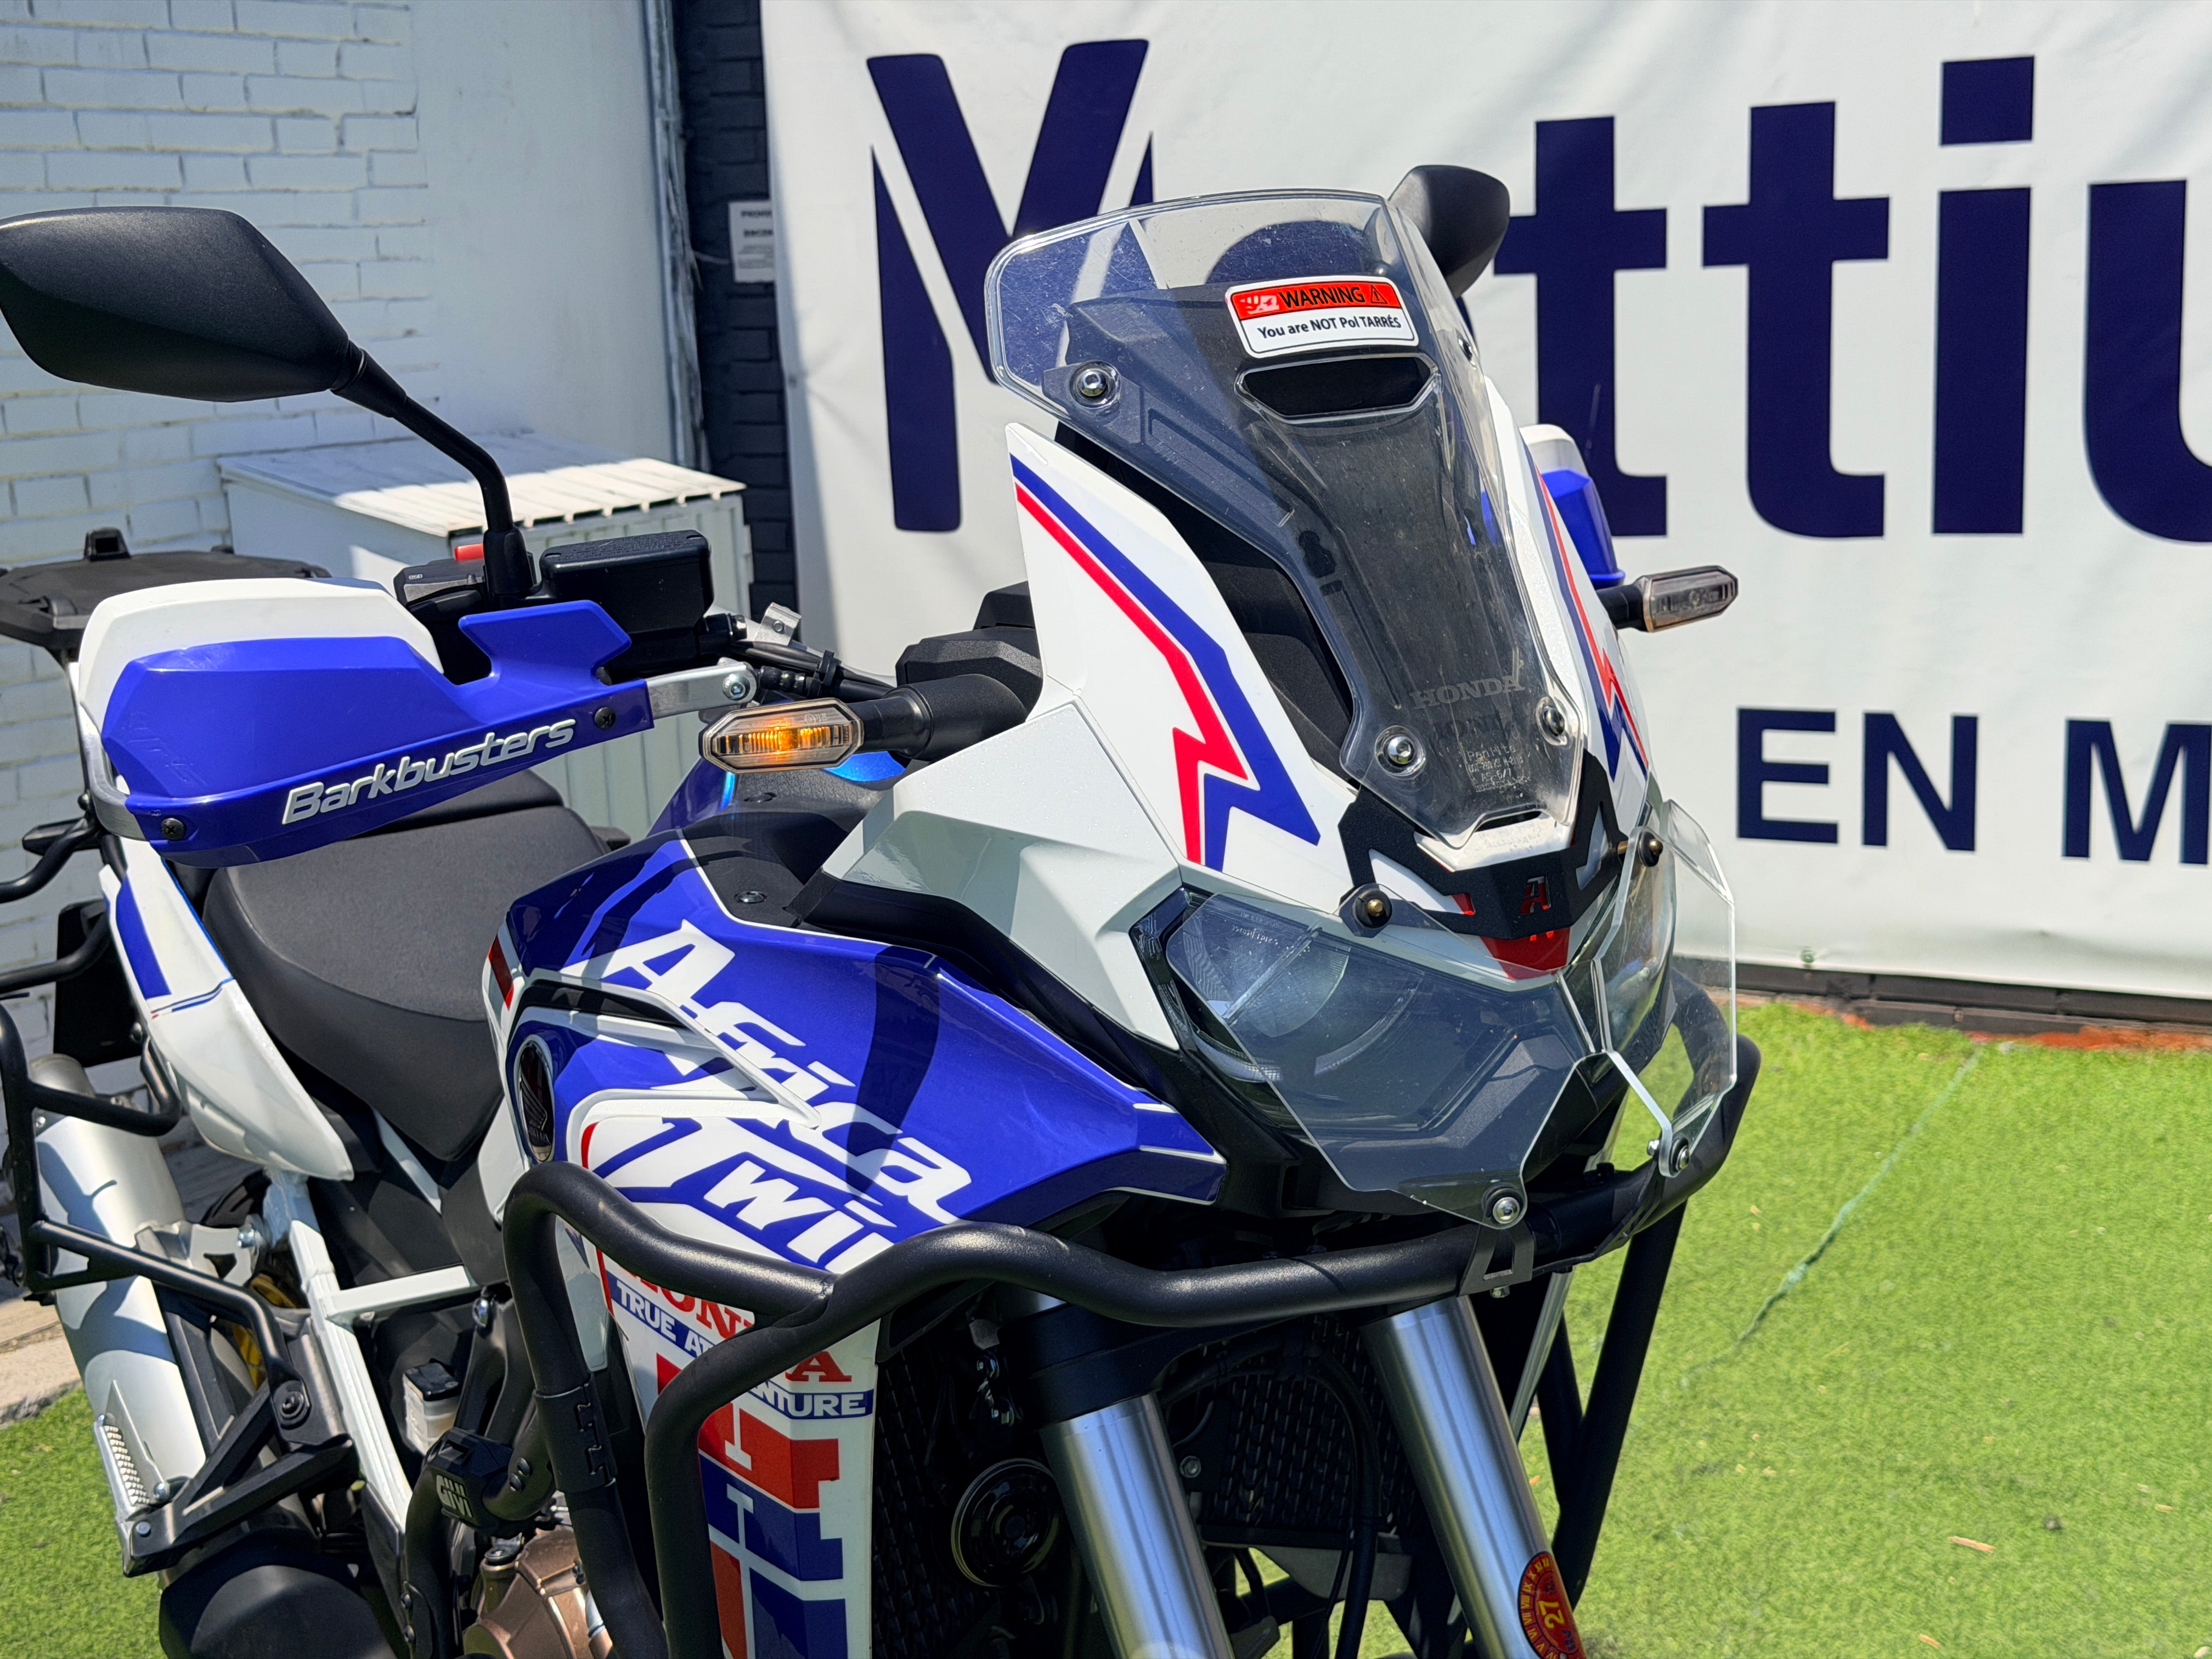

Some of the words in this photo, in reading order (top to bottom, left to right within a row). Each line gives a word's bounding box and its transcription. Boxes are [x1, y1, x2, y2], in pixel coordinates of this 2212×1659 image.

[1278, 286, 1365, 308] WARNING
[1257, 326, 1285, 339] You
[1288, 323, 1310, 334] are
[1310, 317, 1336, 331] NOT
[1340, 315, 1359, 329] Pol
[1359, 313, 1401, 329] TARRÉS
[1408, 675, 1525, 709] HONDA
[282, 719, 576, 825] Barkbusters
[1736, 707, 1979, 853] EN
[560, 919, 972, 1224] Africa
[616, 1279, 676, 1342] TRUE
[1538, 1600, 1565, 1629] 27
